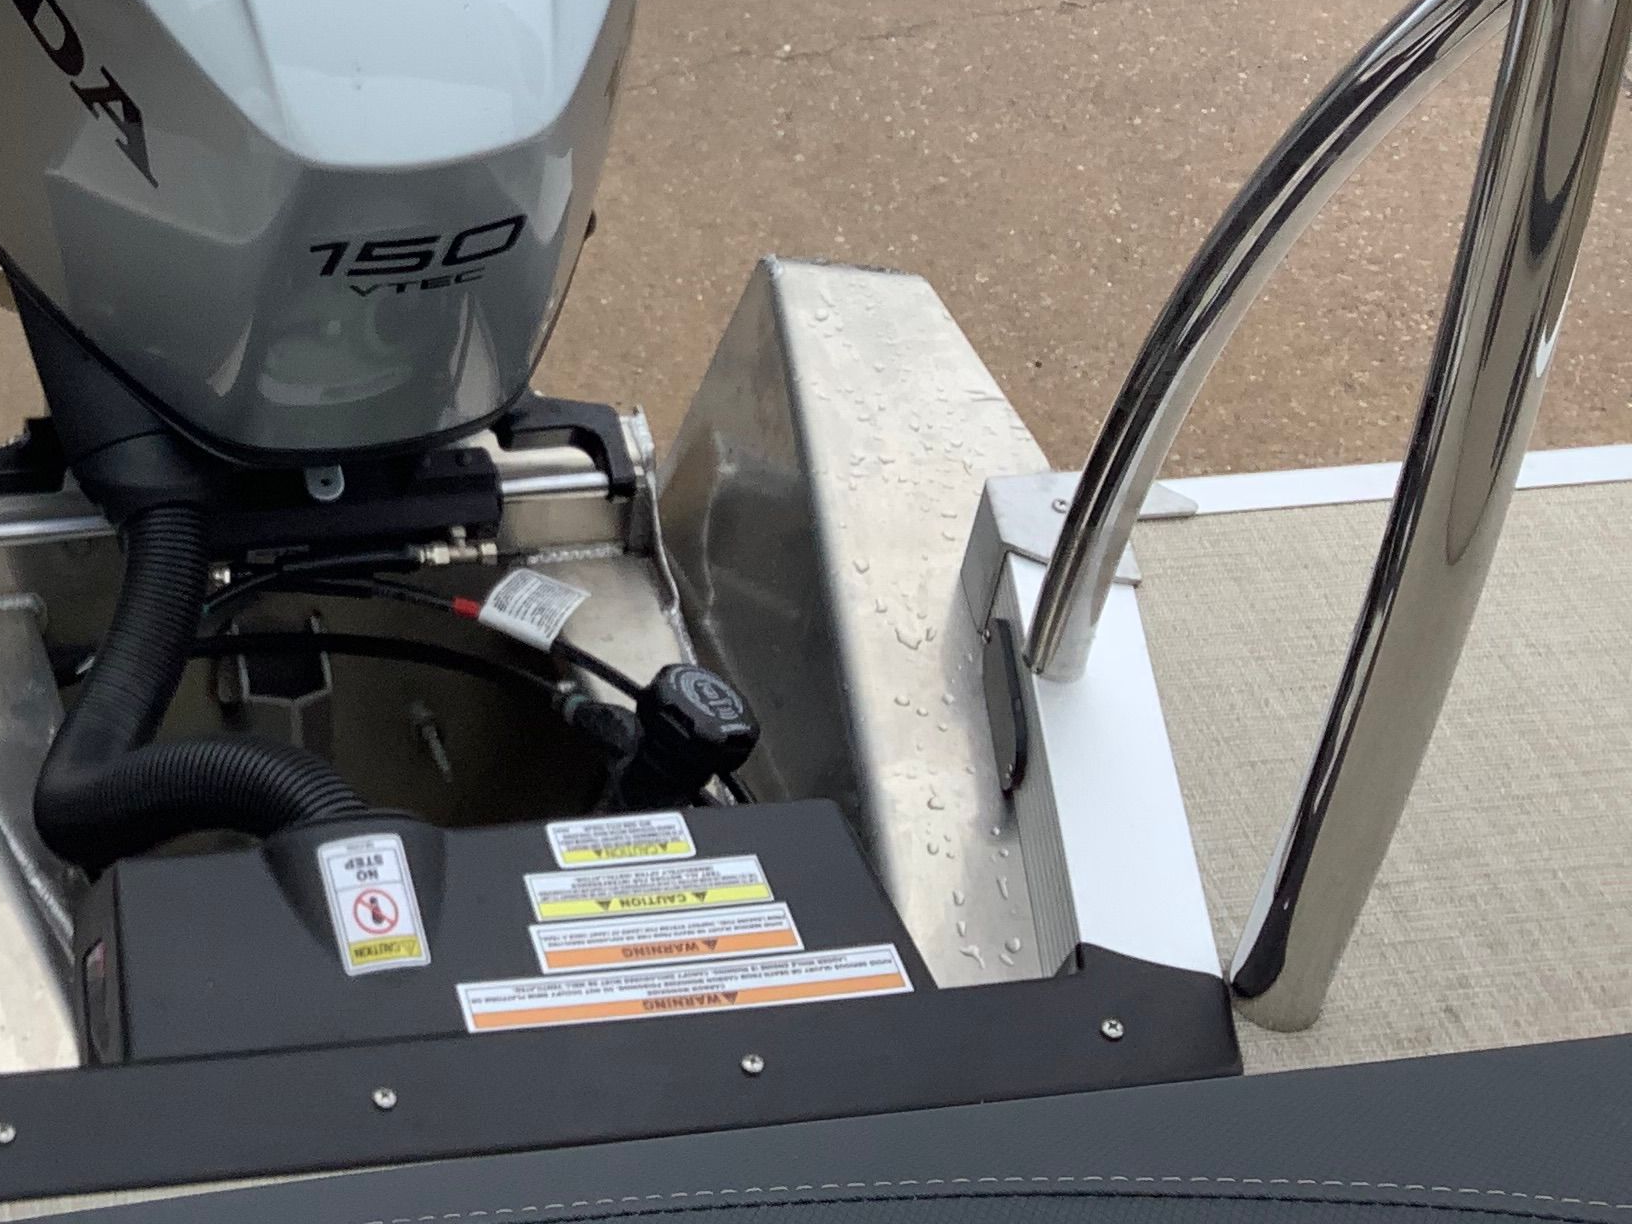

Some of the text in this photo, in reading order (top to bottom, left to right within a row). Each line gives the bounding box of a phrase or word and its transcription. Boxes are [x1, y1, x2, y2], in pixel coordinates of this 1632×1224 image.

[310, 214, 528, 277] 150
[349, 267, 485, 297] VTEC
[604, 844, 659, 858] CAUTION
[344, 854, 384, 870] STEP
[356, 869, 379, 882] NO
[618, 893, 687, 908] CAUTION
[354, 943, 401, 959] CAUTION
[620, 941, 700, 958] WARNING
[640, 992, 723, 1010] WARNING
